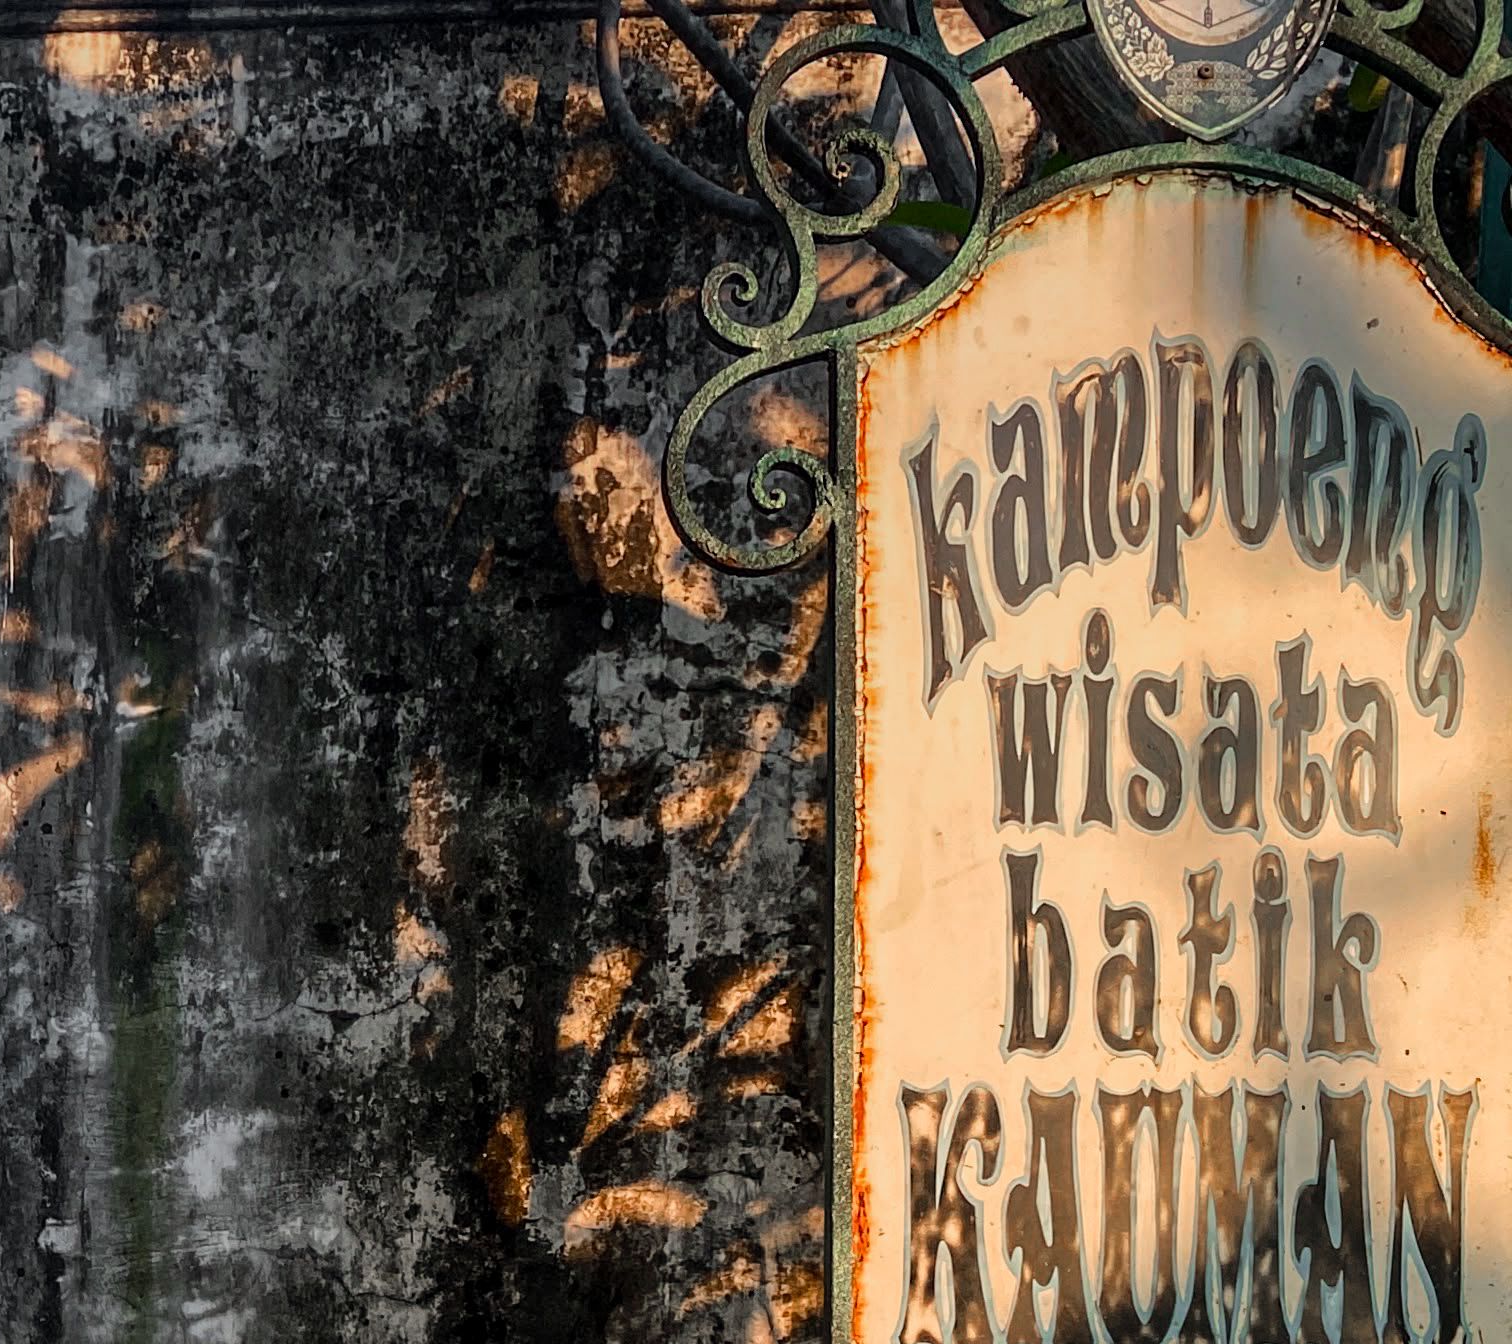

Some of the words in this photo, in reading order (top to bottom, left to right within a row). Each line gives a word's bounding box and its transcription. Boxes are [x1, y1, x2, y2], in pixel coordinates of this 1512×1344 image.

[901, 328, 1486, 737] kampoeng
[983, 608, 1402, 846] wisata
[998, 845, 1381, 1066] batik
